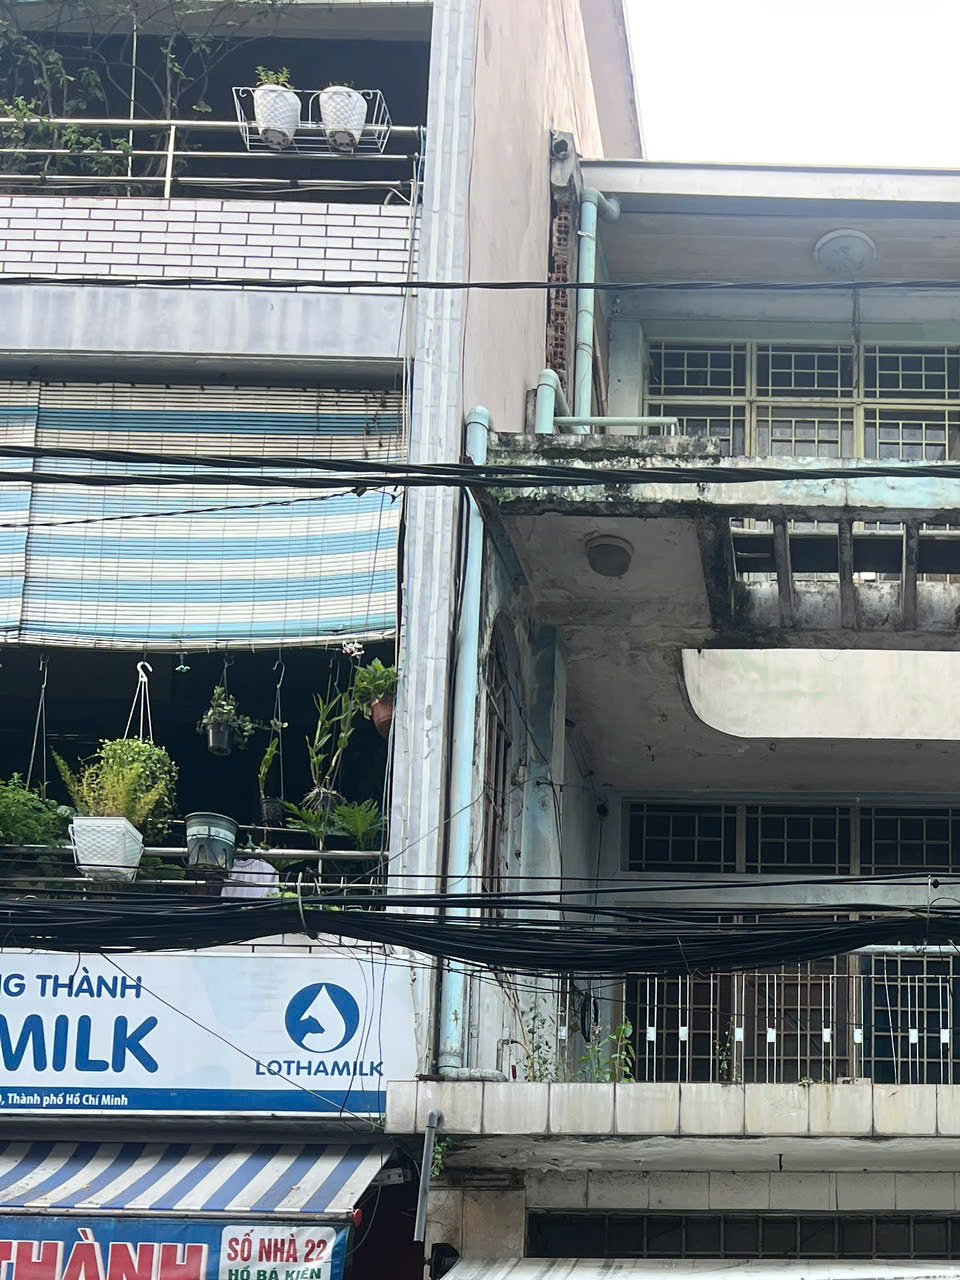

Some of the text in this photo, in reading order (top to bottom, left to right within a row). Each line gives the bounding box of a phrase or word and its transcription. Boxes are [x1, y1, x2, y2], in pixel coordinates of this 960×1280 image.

[0, 966, 142, 998] G THÀNH
[255, 1060, 384, 1077] LOTHAMILK
[7, 1092, 40, 1105] Thành
[43, 1092, 65, 1107] phố
[82, 1094, 100, 1106] Chí
[101, 1094, 128, 1106] Minh
[227, 1229, 327, 1263] SỐ NHÀ 22
